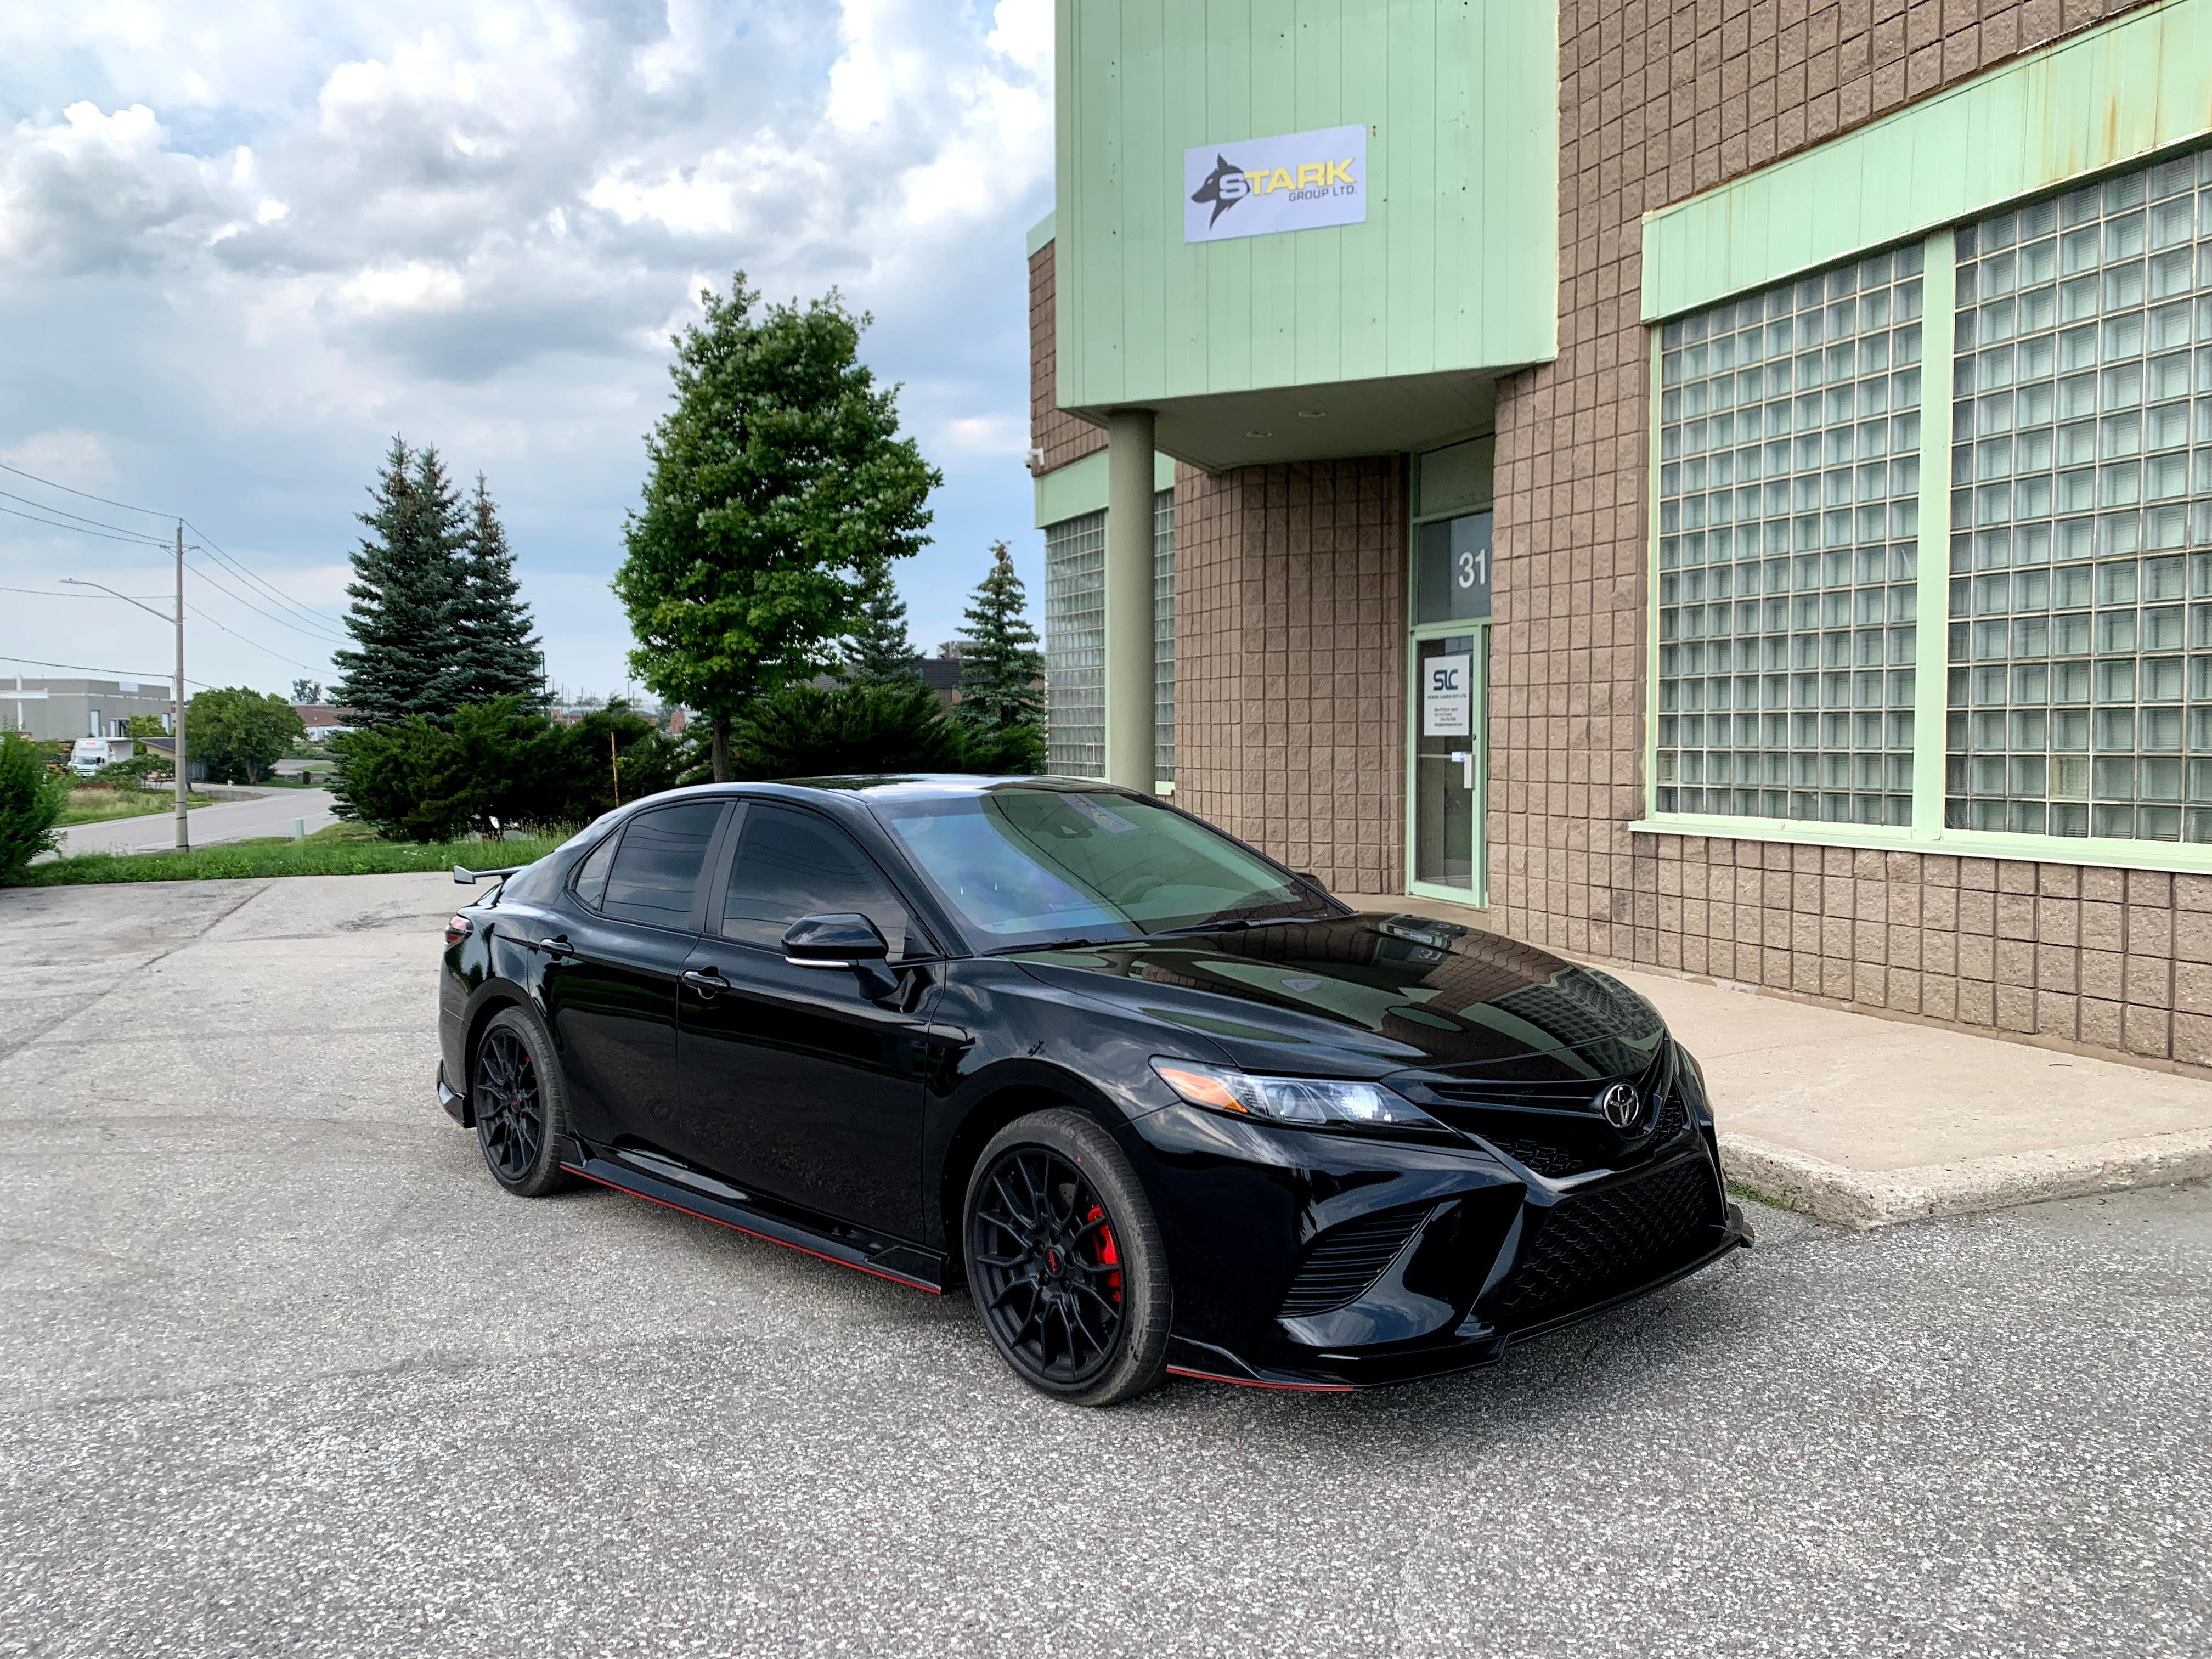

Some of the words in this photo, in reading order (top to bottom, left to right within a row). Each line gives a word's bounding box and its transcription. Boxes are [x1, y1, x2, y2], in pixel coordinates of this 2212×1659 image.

[1219, 157, 1356, 200] STARK
[1289, 188, 1328, 201] GROUP
[1333, 185, 1357, 196] LTD.
[1458, 549, 1485, 589] 31
[1433, 668, 1458, 691] SLC
